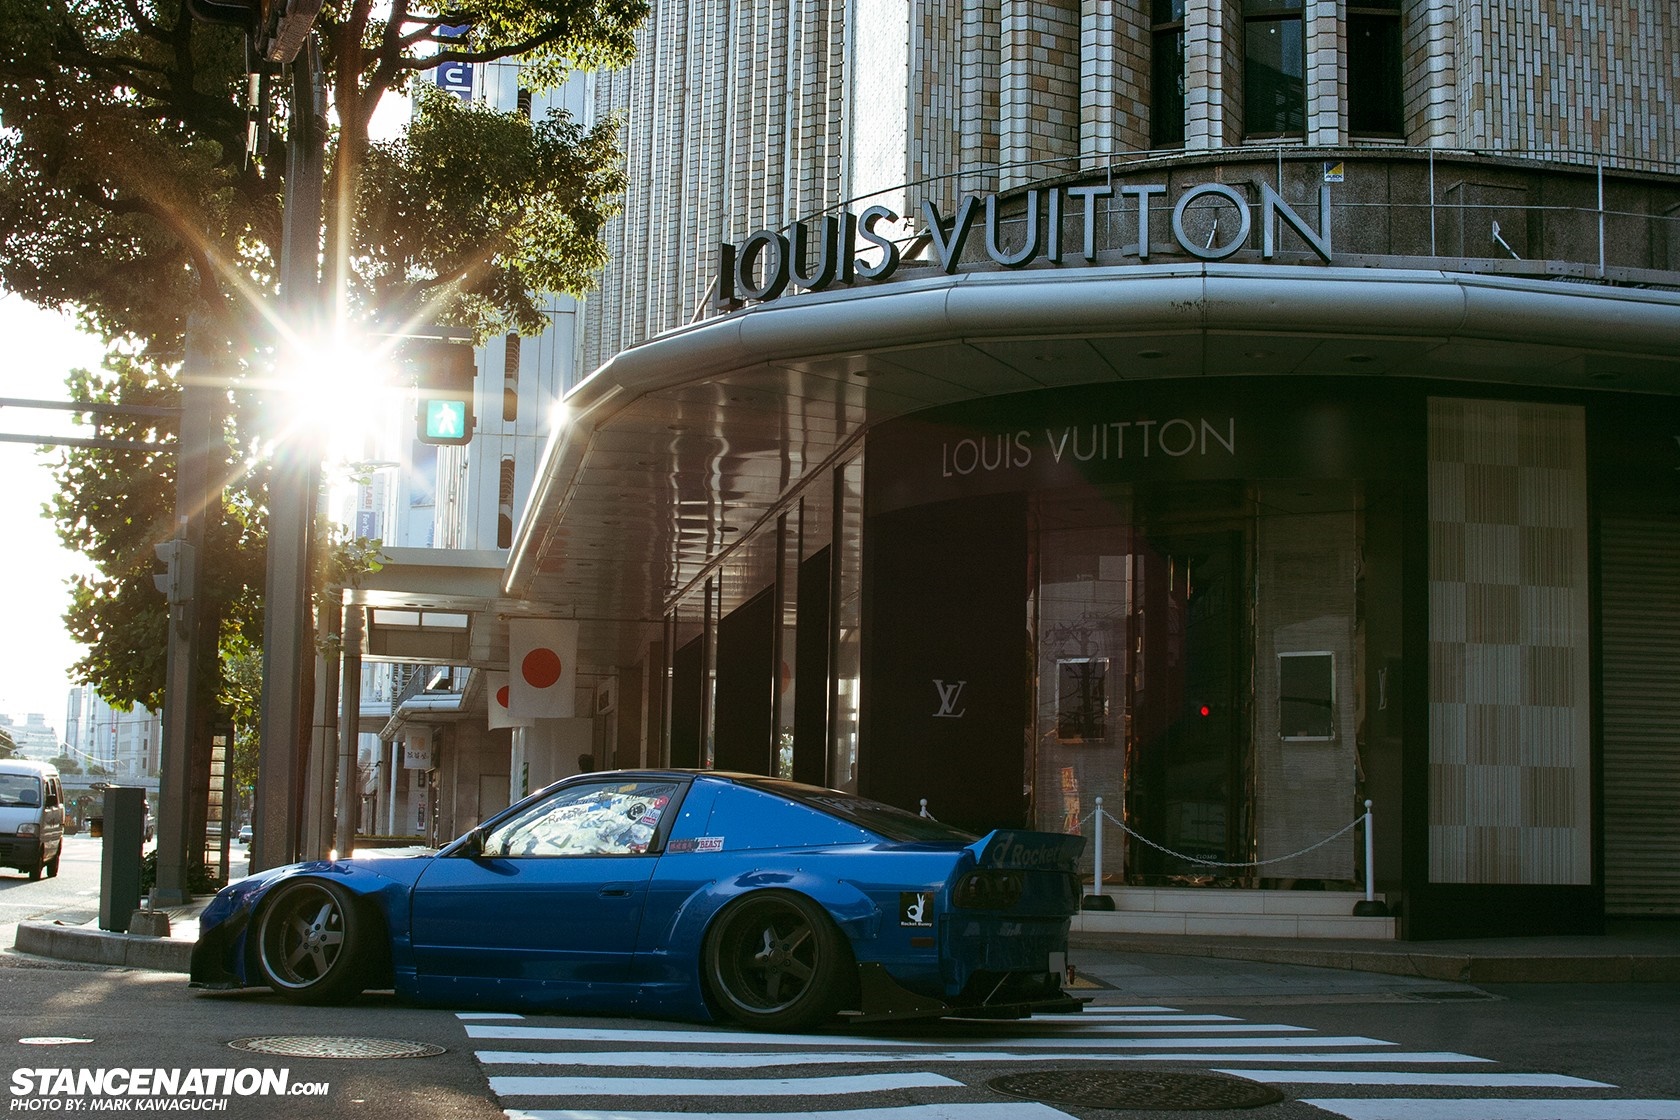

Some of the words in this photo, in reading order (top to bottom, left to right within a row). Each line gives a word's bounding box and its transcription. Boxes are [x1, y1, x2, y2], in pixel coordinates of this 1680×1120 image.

[717, 205, 899, 309] LOUIS
[923, 181, 1332, 274] VUITTON
[942, 430, 1031, 478] LOUIS
[1046, 417, 1235, 464] VUITTON
[699, 839, 723, 849] BEAST
[1011, 843, 1059, 865] Rocket
